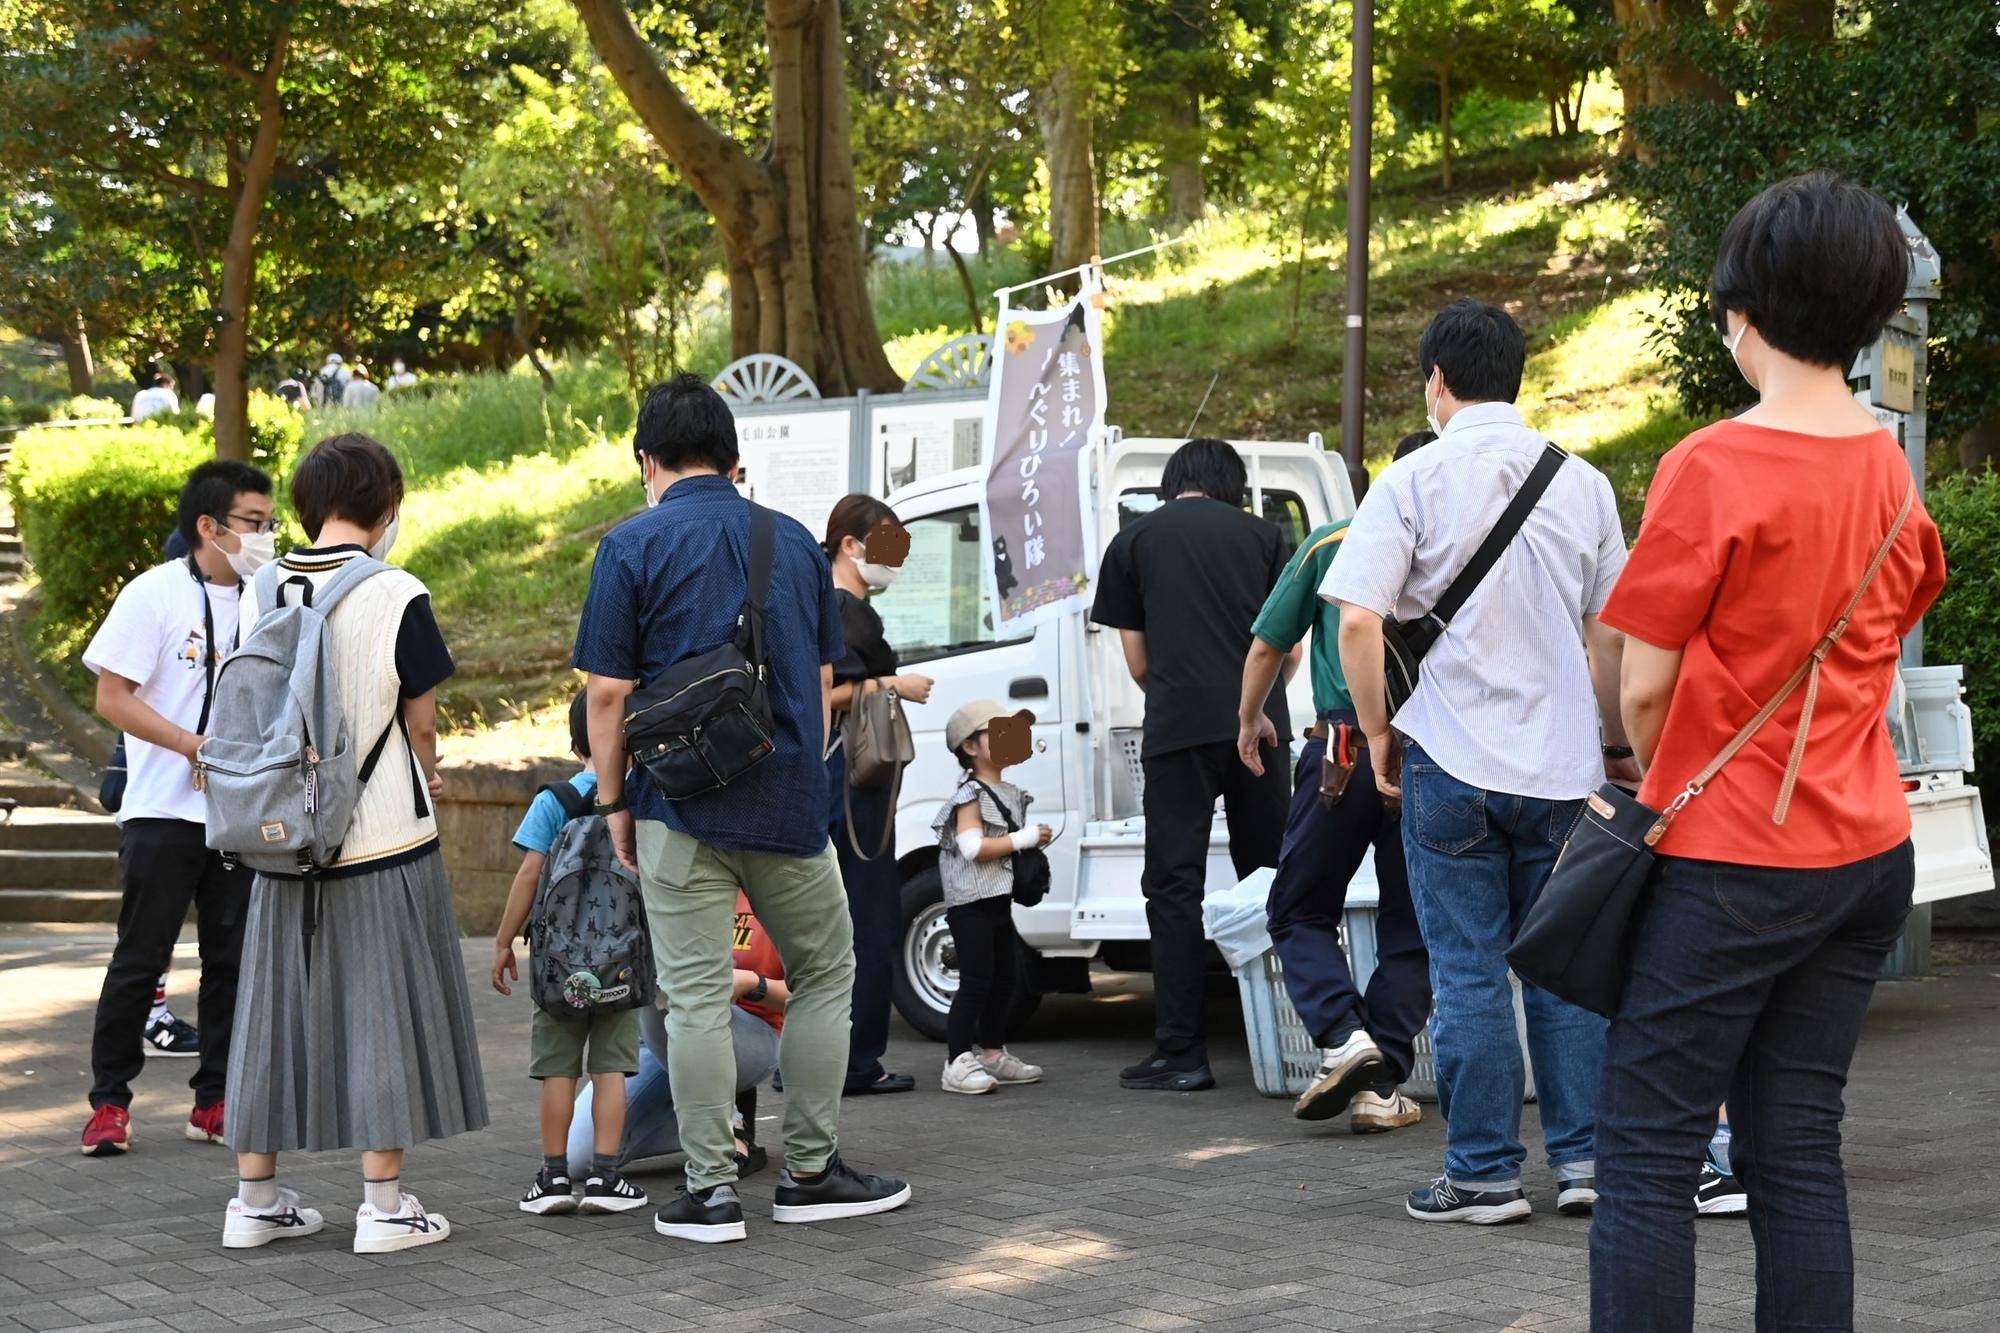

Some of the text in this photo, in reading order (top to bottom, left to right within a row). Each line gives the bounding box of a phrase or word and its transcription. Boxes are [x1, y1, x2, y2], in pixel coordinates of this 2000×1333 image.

[1020, 347, 1053, 570] んぐりひろい隊
